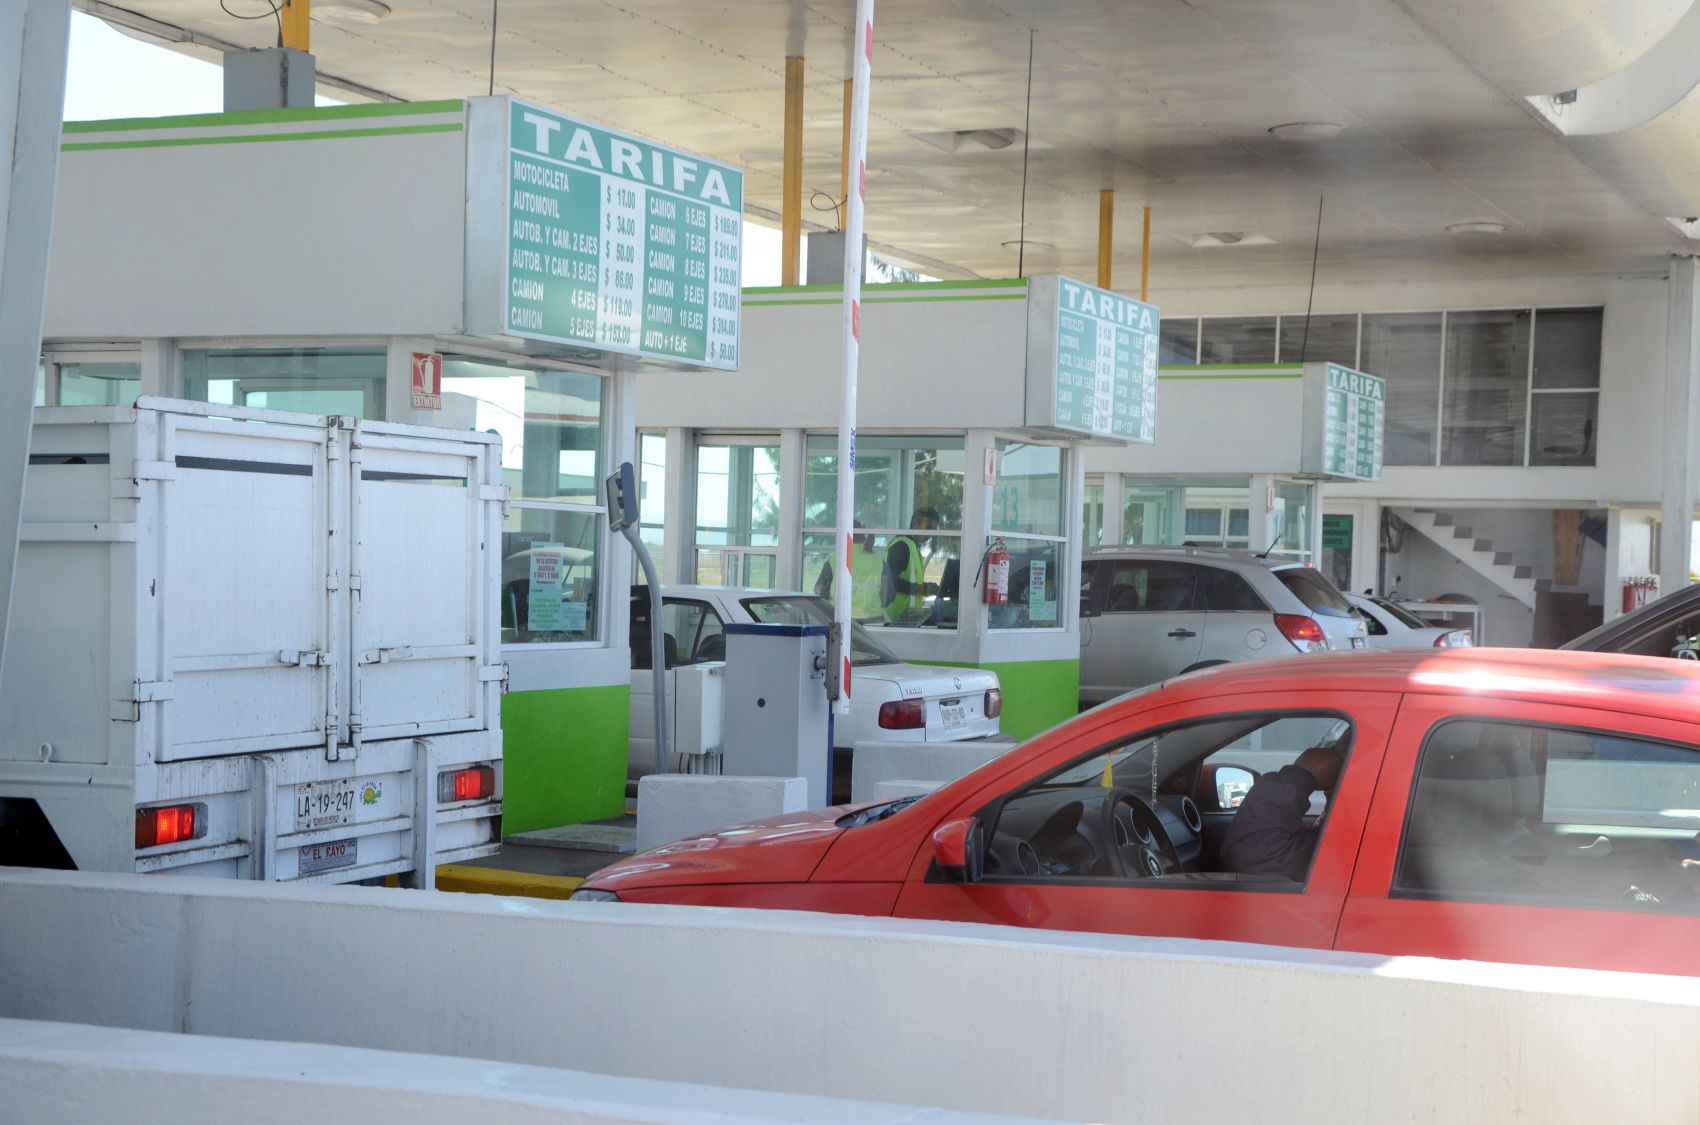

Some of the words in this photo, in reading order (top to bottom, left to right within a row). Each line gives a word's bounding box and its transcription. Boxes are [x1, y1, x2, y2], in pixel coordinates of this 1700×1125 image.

[524, 112, 730, 206] TARIFA
[514, 160, 569, 192] MOTOCICLETA
[607, 185, 611, 204] $
[618, 188, 636, 209] 17.00
[513, 190, 560, 219] AUTOMOVIL
[606, 212, 610, 231] $
[617, 216, 635, 236] 34.00
[650, 197, 676, 220] CAMION
[686, 207, 690, 223] 6
[691, 208, 706, 228] EJES
[513, 220, 543, 243] AUTOB.
[544, 226, 550, 245] Y
[552, 228, 571, 250] CAM.
[573, 232, 578, 250] 2
[579, 234, 598, 256] EJES
[606, 240, 610, 259] $
[650, 224, 676, 246] CAMION
[686, 232, 690, 249] 7
[691, 234, 706, 253] EJES
[512, 250, 542, 272] AUTOB.
[544, 255, 550, 273] Y
[552, 256, 570, 279] CAM.
[572, 261, 576, 279] 3
[578, 262, 597, 283] EJES
[605, 267, 609, 286] $
[649, 250, 675, 272] CAMION
[690, 259, 705, 279] EJES
[512, 278, 544, 302] CAMION
[571, 288, 576, 307] 4
[578, 290, 596, 311] EJES
[648, 278, 674, 299] CAMION
[684, 284, 688, 300] 9
[689, 286, 704, 305] EJES
[1064, 283, 1153, 331] TARIFA
[512, 306, 542, 330] CAMION
[570, 316, 574, 334] 5
[576, 318, 595, 338] EJES
[647, 304, 672, 325] CAMION
[680, 310, 686, 326] 10
[688, 310, 703, 330] EJES
[644, 330, 662, 349] AUTO
[675, 336, 688, 352] EJE
[1330, 368, 1381, 399] TARIFA
[298, 790, 354, 818] LA-19-247
[313, 848, 322, 860] EL
[326, 844, 346, 858] RAYO
